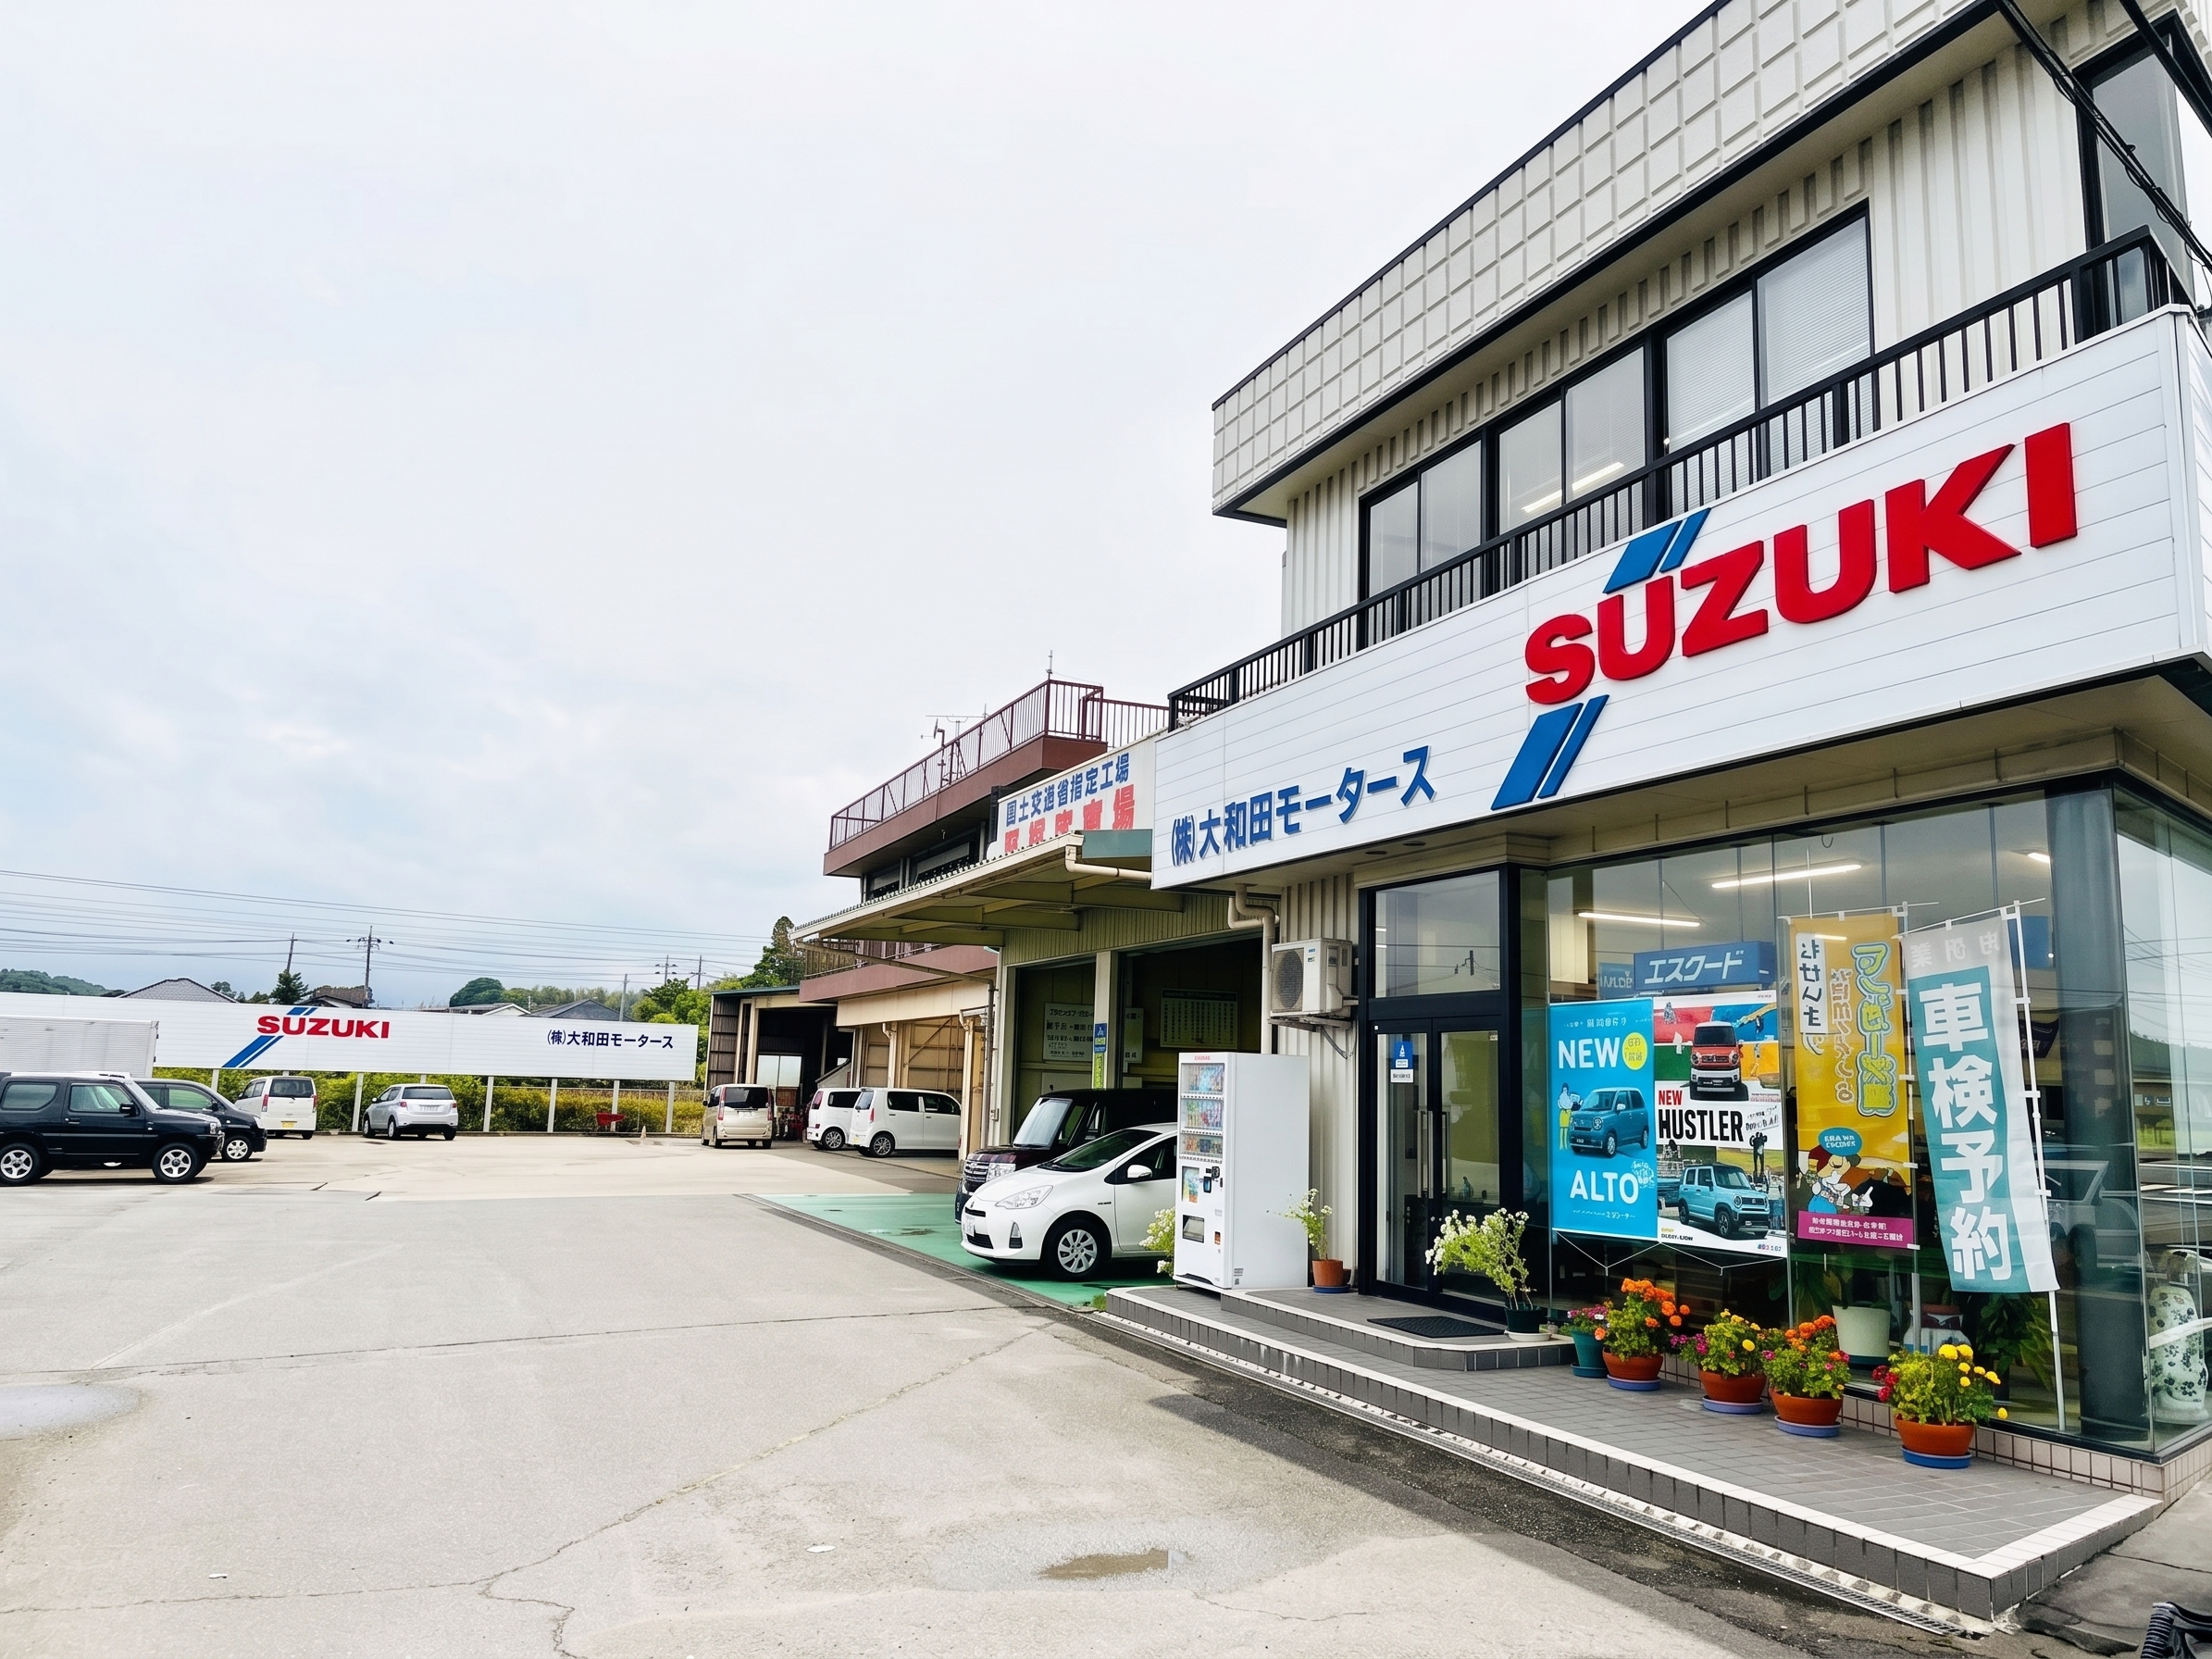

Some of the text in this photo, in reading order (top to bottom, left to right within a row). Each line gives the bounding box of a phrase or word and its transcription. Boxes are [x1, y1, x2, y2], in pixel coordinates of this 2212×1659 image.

[1524, 422, 2078, 705] SUZUKI
[1171, 744, 1436, 867] (株)大和田モータース
[1644, 949, 1745, 985] エスクード
[257, 1016, 390, 1039] SUZUKI
[1558, 1037, 1621, 1069] NEW
[1659, 1090, 1683, 1105] NEW
[1658, 1108, 1745, 1143] HUSTLER
[1919, 982, 2013, 1282] 車検予約
[1570, 1169, 1640, 1204] ALTO
